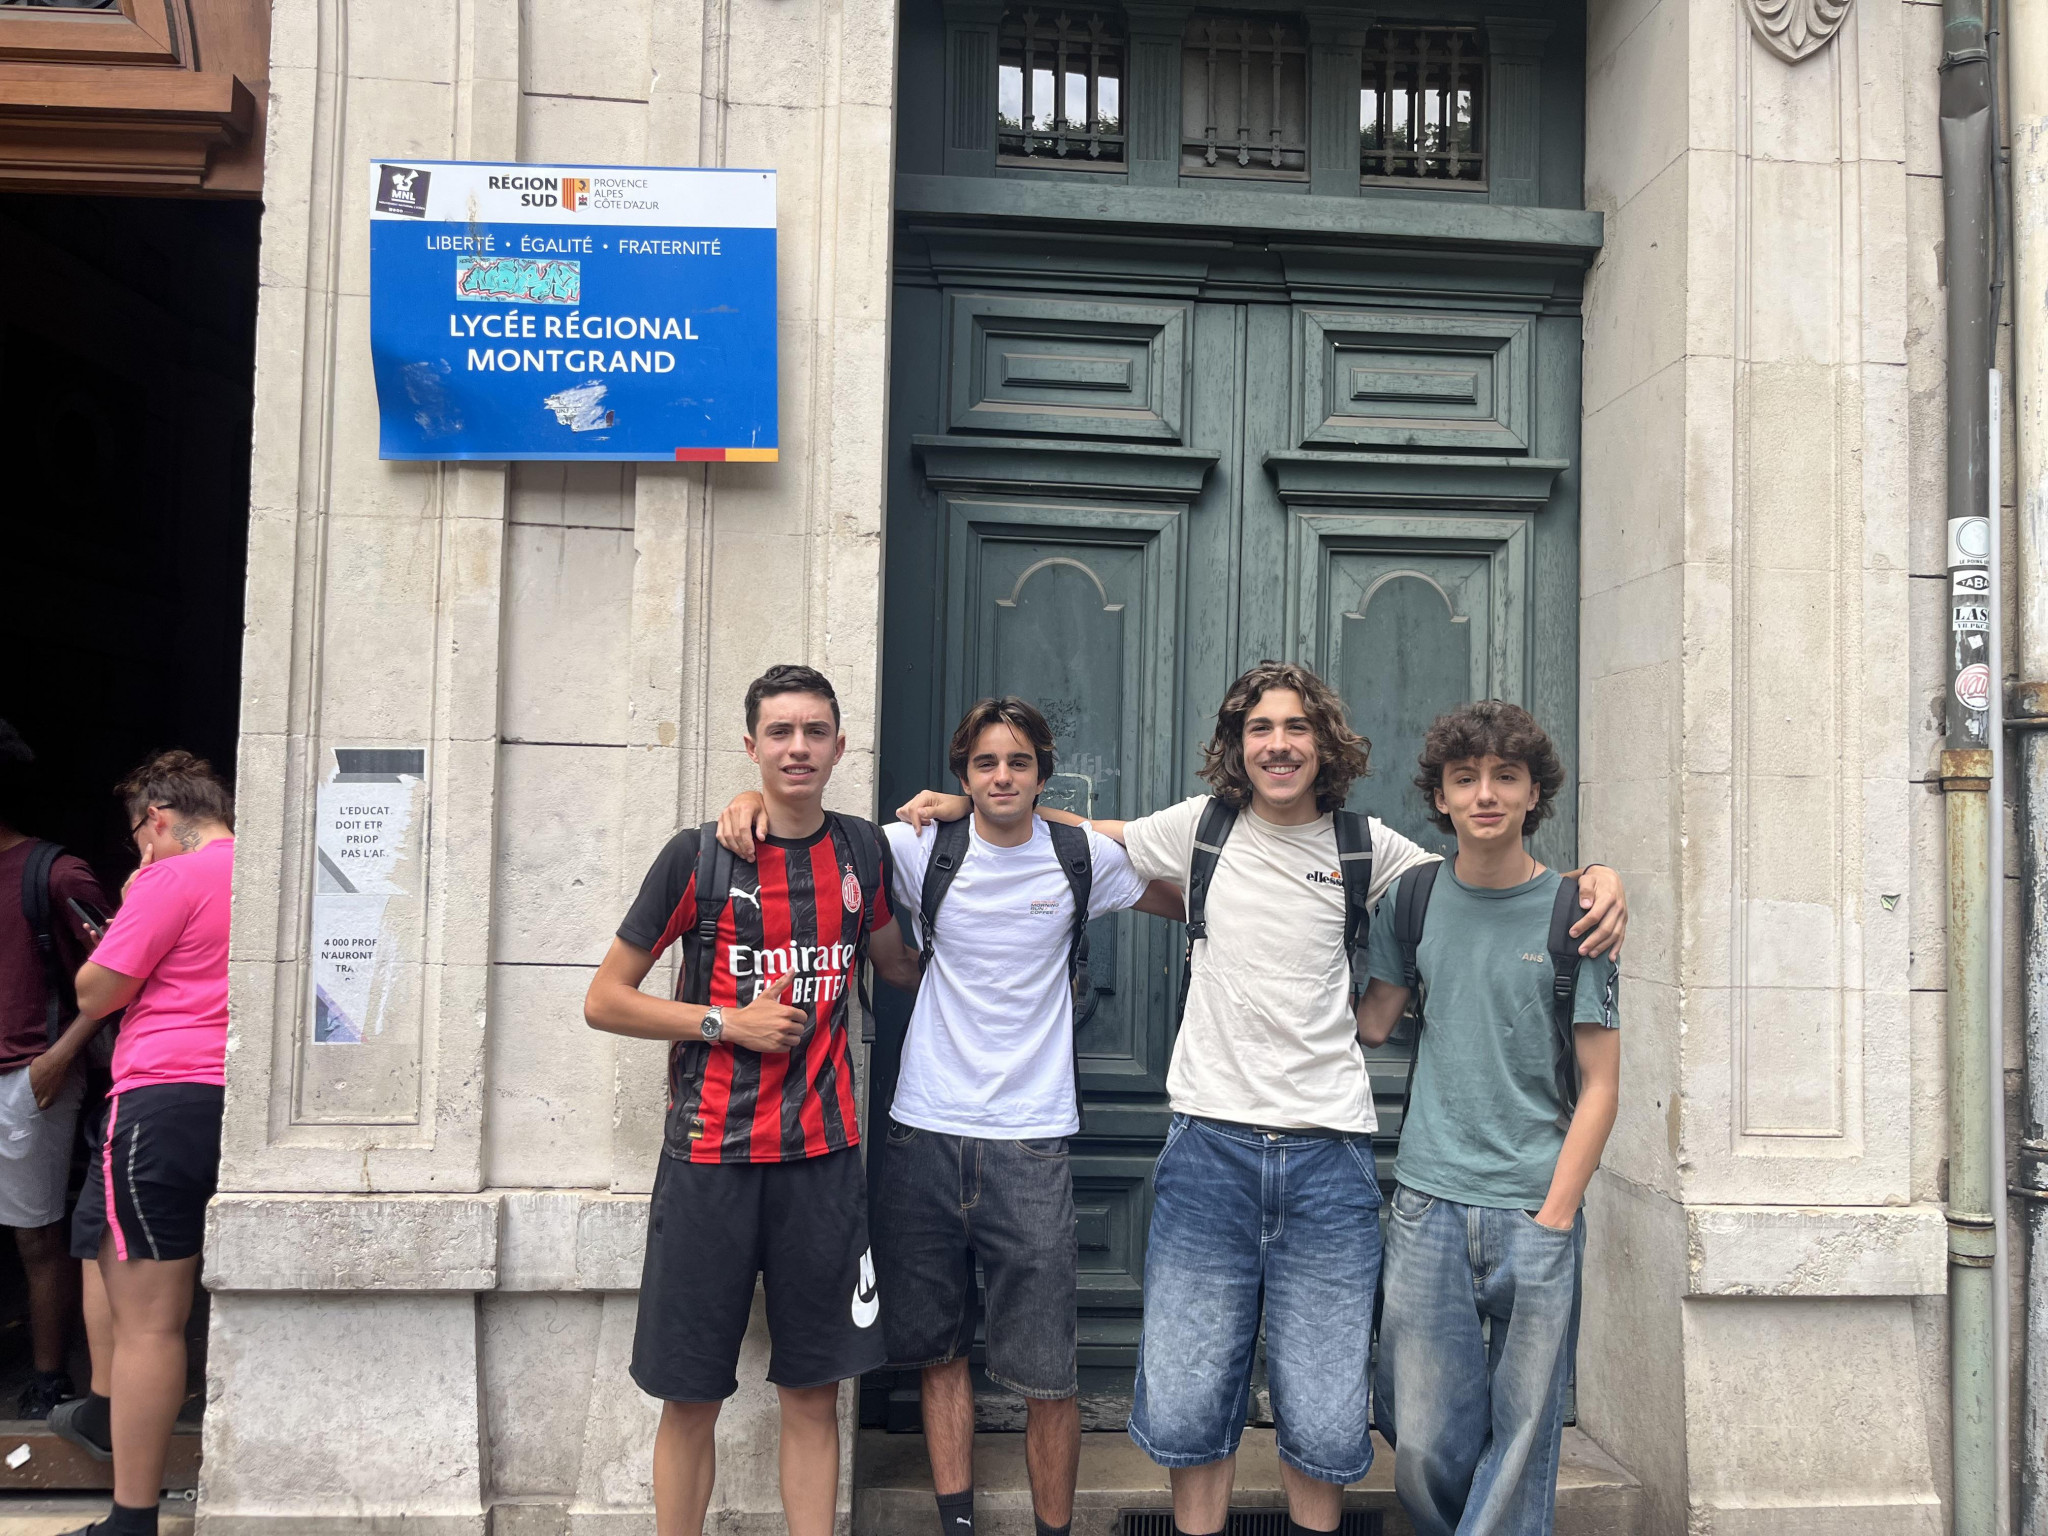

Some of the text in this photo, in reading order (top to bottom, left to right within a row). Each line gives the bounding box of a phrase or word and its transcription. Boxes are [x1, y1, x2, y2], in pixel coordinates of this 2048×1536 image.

[489, 174, 558, 190] RÉGION
[594, 178, 648, 189] PROVENCE
[392, 189, 416, 201] MNL
[594, 189, 624, 198] ALPES
[521, 194, 558, 208] SUD
[594, 198, 660, 210] CÔTE D'AZUR
[427, 235, 722, 256] LIBERTÉ ÉGALITÉ FRATERNITÉ
[450, 309, 699, 340] LYCÉE RÉGIONAL
[467, 348, 676, 374] MONTGRAND
[1955, 608, 1989, 621] LAS
[340, 806, 391, 815] L'EDUCAT
[335, 820, 361, 829] DOIT
[341, 849, 361, 858] PAS
[324, 938, 377, 947] 4 000 PROF
[321, 951, 373, 960] N'AURONT
[728, 940, 857, 977] Emirate
[1519, 951, 1544, 963] ANS
[335, 964, 356, 973] TRA
